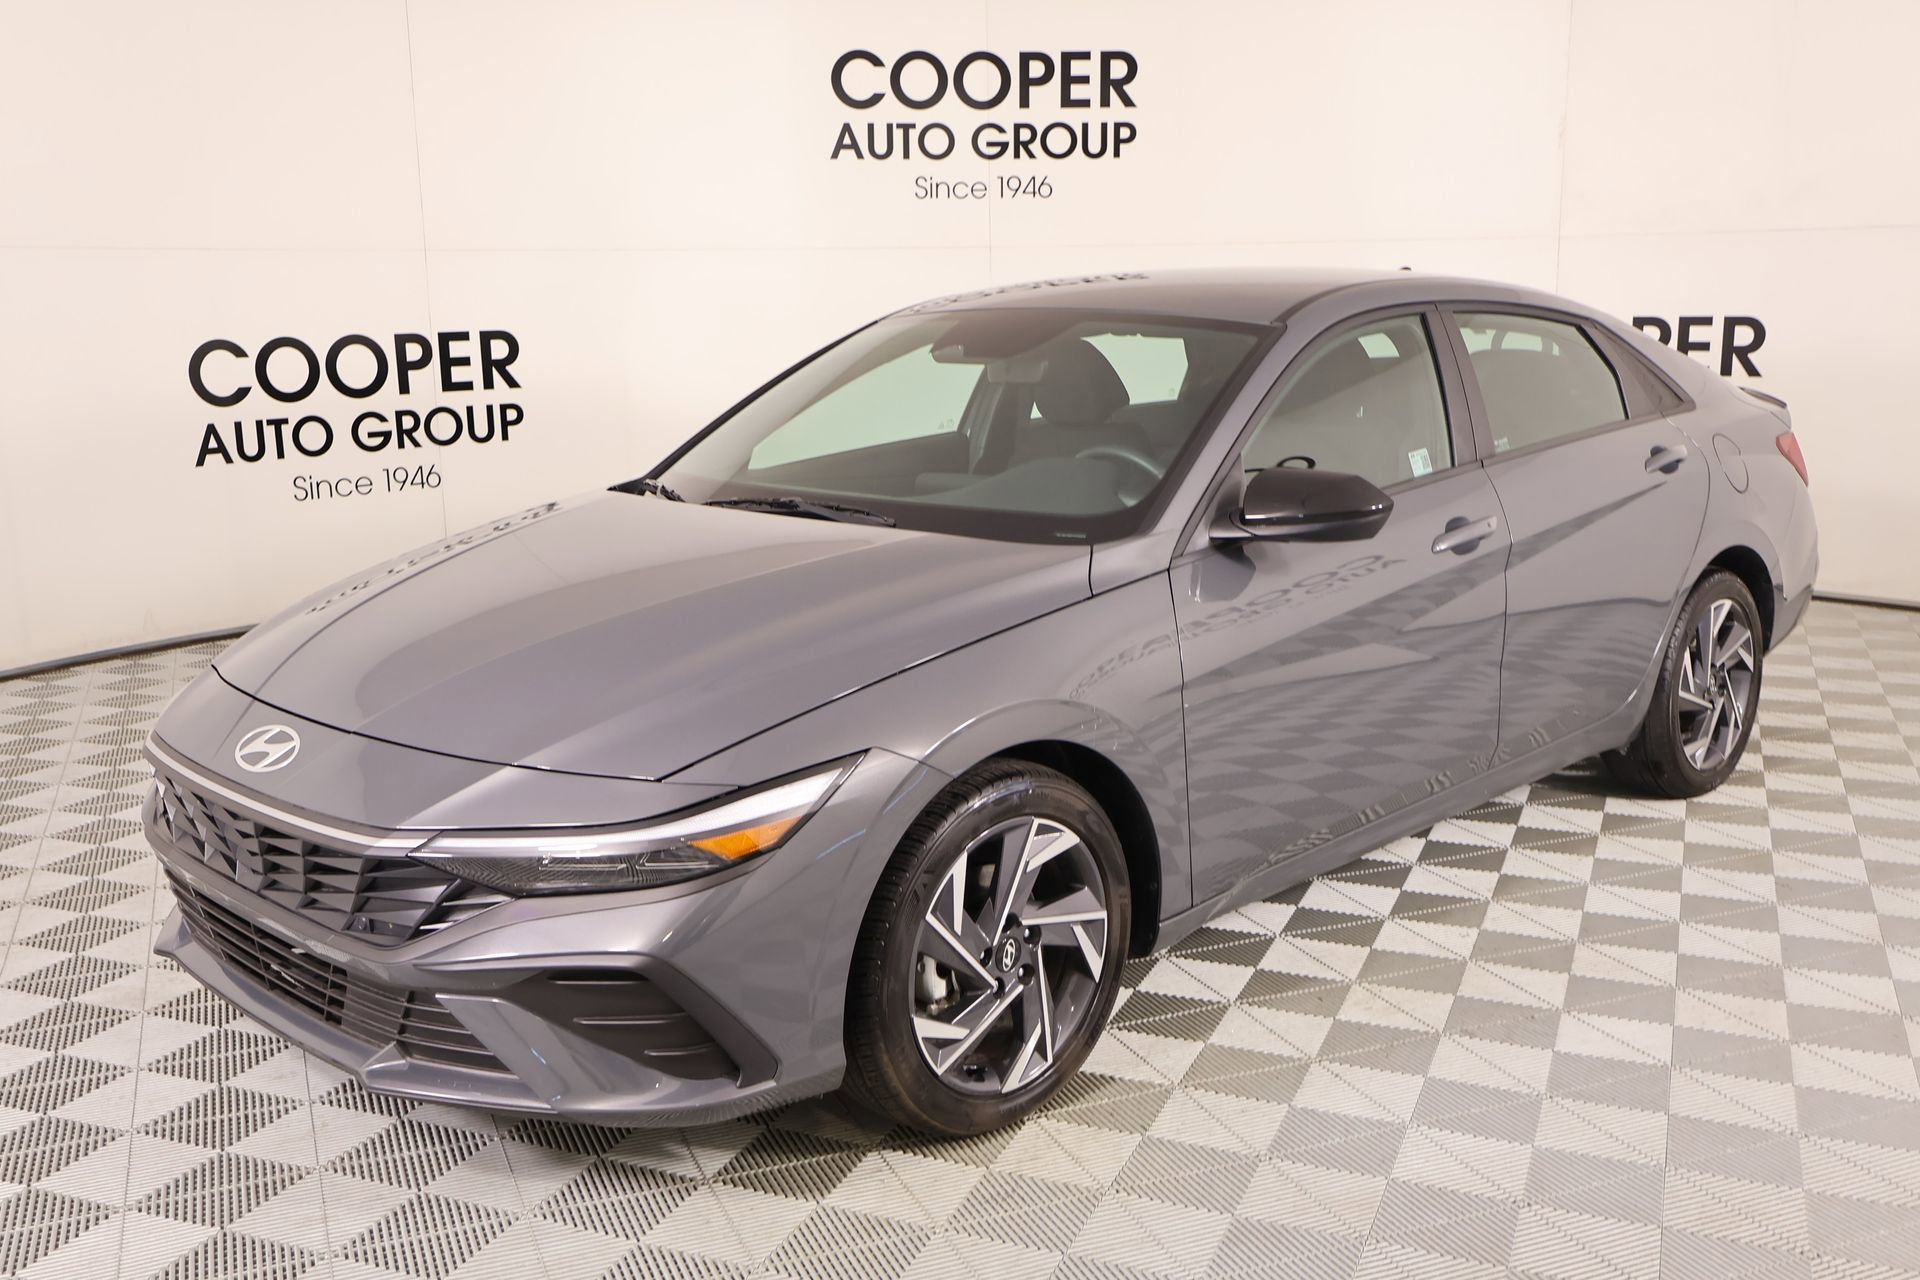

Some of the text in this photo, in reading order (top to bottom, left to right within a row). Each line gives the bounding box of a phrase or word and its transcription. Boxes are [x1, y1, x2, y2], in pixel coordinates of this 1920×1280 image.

[830, 49, 1139, 110] COOPER
[830, 121, 1138, 160] AUTO GROUP
[914, 175, 1053, 200] Since 1946
[188, 329, 522, 408] COOPER
[194, 402, 525, 467] AUTO GROUP
[292, 463, 442, 502] Since 1946
